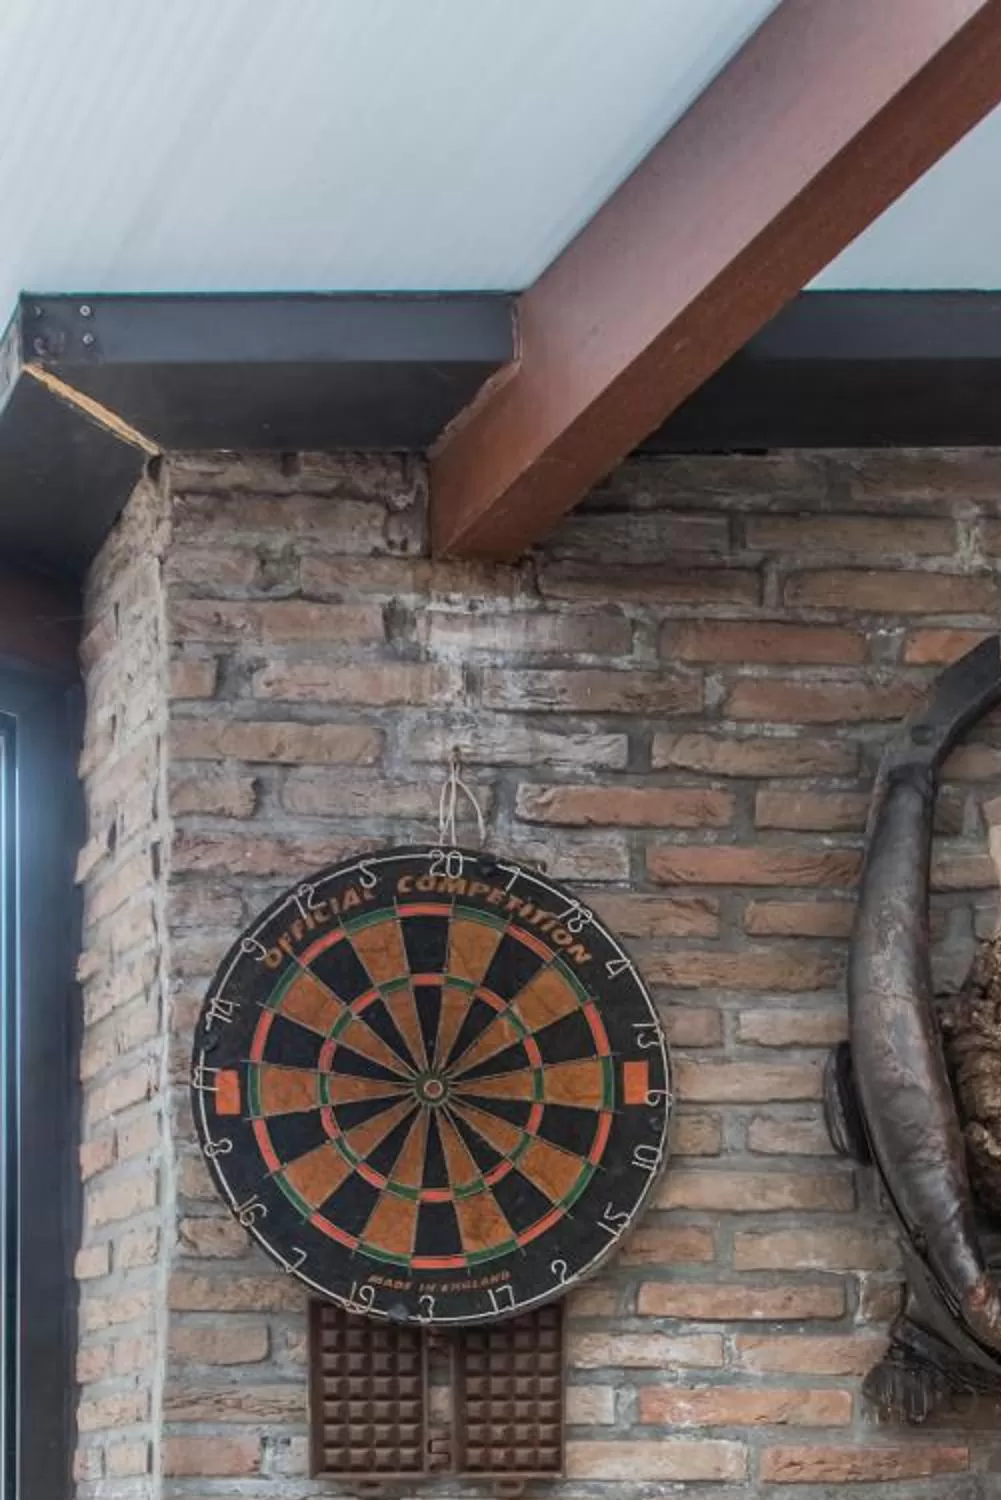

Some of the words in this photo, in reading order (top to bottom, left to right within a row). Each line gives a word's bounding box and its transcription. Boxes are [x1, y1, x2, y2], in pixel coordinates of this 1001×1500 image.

[357, 858, 377, 889] 5
[429, 849, 463, 878] 20
[503, 866, 521, 894] 1
[292, 882, 327, 921] 12
[264, 884, 376, 968] OFFICIAL
[397, 875, 592, 964] COMPETITION
[556, 900, 594, 934] 18
[241, 936, 268, 964] 9
[605, 957, 632, 979] 4
[631, 1022, 664, 1050] 13
[203, 1137, 233, 1158] 8
[631, 1144, 662, 1173] 10
[234, 1195, 268, 1229] 16
[597, 1203, 631, 1236] 15
[284, 1246, 308, 1273] 7
[551, 1259, 570, 1284] 2
[367, 1274, 412, 1292] MADE
[417, 1277, 437, 1293] IN
[440, 1271, 512, 1291] ENGLAND
[346, 1279, 376, 1315] 19
[418, 1294, 437, 1321] 3
[488, 1285, 517, 1314] 17
